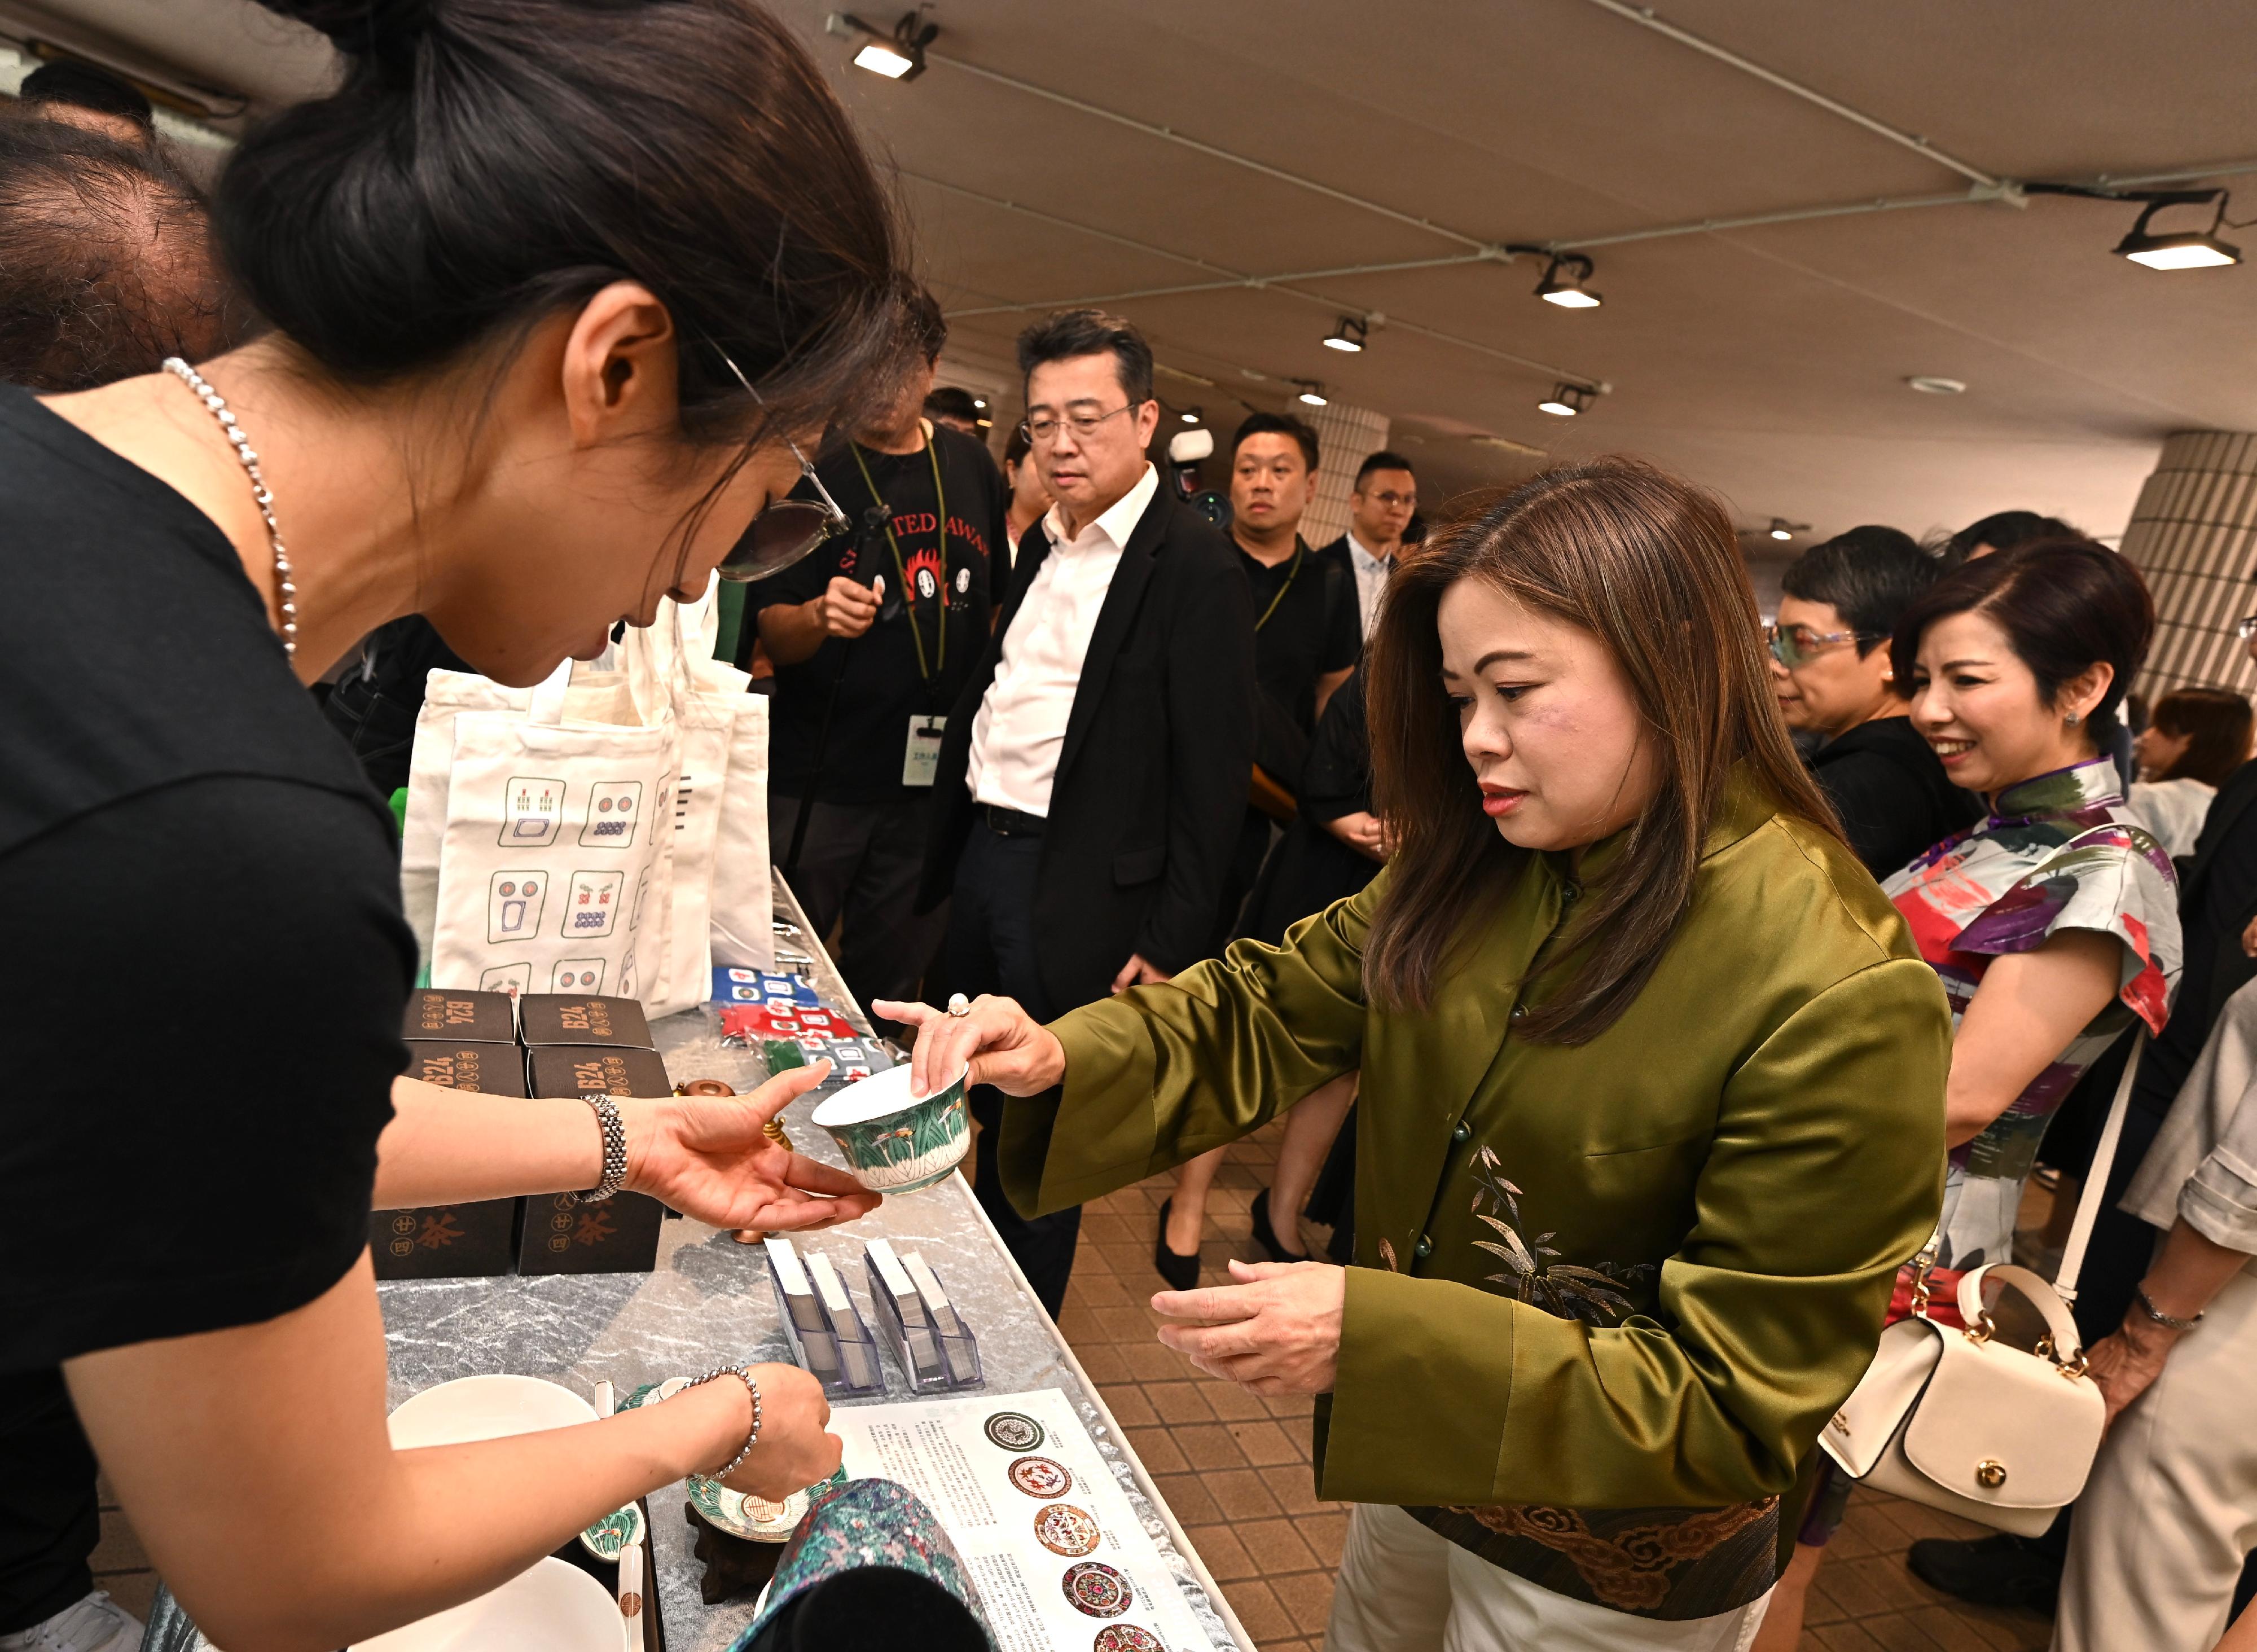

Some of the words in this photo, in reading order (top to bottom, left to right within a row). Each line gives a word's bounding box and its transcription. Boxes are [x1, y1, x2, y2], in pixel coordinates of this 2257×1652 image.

[446, 1001, 474, 1023] B24
[560, 1006, 589, 1029] B24
[423, 1057, 454, 1084] B24
[574, 1062, 607, 1088] B24
